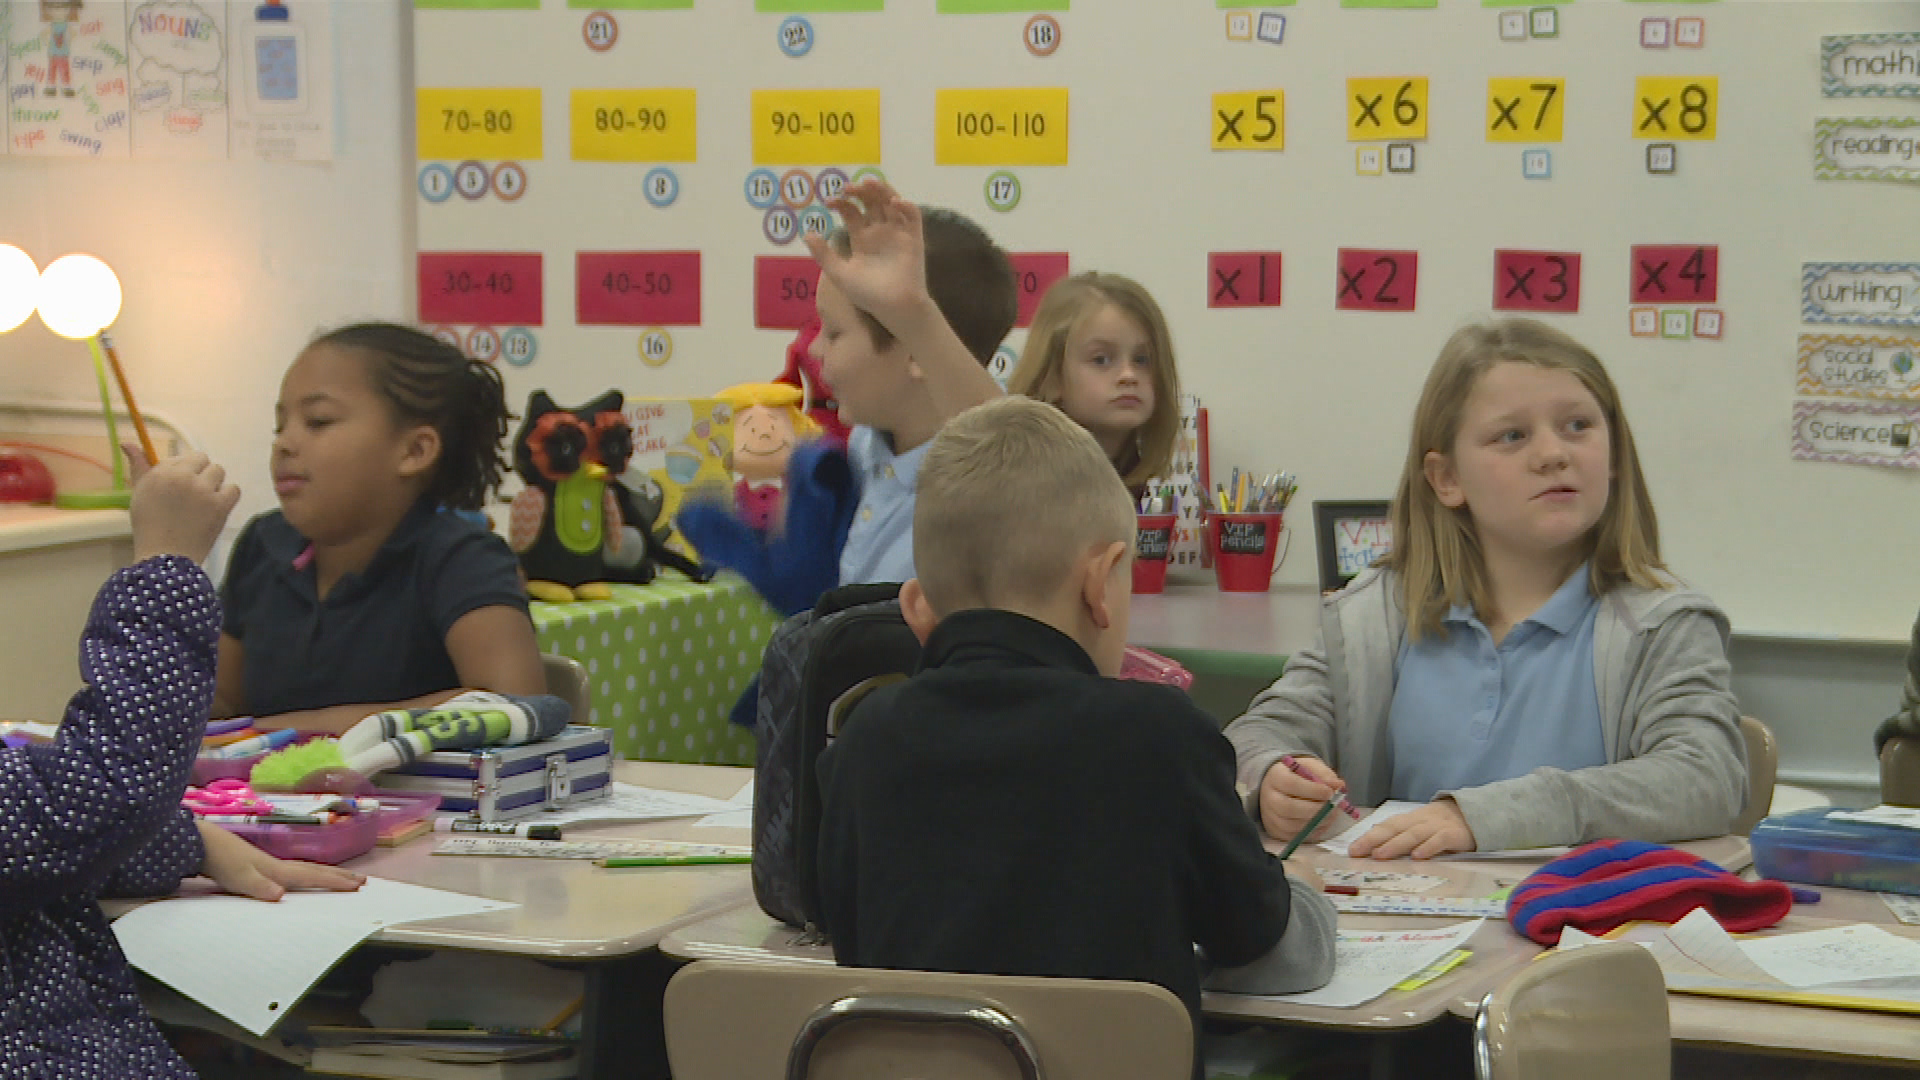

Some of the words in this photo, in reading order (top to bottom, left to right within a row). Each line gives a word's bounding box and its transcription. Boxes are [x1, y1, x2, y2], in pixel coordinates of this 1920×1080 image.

[138, 12, 213, 41] NOUNS
[590, 22, 609, 39] 21
[785, 24, 807, 46] 22
[1032, 24, 1053, 45] 18
[1844, 49, 1914, 75] math
[1355, 81, 1419, 127] x6
[1491, 83, 1557, 131] x7
[1639, 84, 1708, 133] x8
[442, 109, 513, 132] 70-80
[595, 108, 667, 132] 80-90
[771, 111, 856, 136] 90-100
[956, 111, 1047, 137] 100-110
[1216, 96, 1276, 143] x5
[1832, 133, 1913, 160] reading
[467, 171, 477, 189] 5
[502, 172, 514, 190] 4
[655, 178, 666, 196] 8
[755, 178, 771, 197] 15
[787, 178, 806, 199] 11
[824, 178, 842, 197] 12
[991, 181, 1012, 200] 17
[772, 215, 791, 233] 19
[806, 215, 826, 234] 20
[1339, 257, 1400, 303] x2
[1506, 256, 1569, 302] x3
[1639, 247, 1707, 294] x4
[441, 271, 514, 295] 30-40
[602, 271, 672, 295] 40-50
[1817, 281, 1902, 309] writing
[475, 335, 491, 353] 14
[510, 338, 527, 355] 13
[646, 336, 663, 355] 16
[1224, 522, 1254, 537] VIP
[1341, 519, 1392, 546] VI
